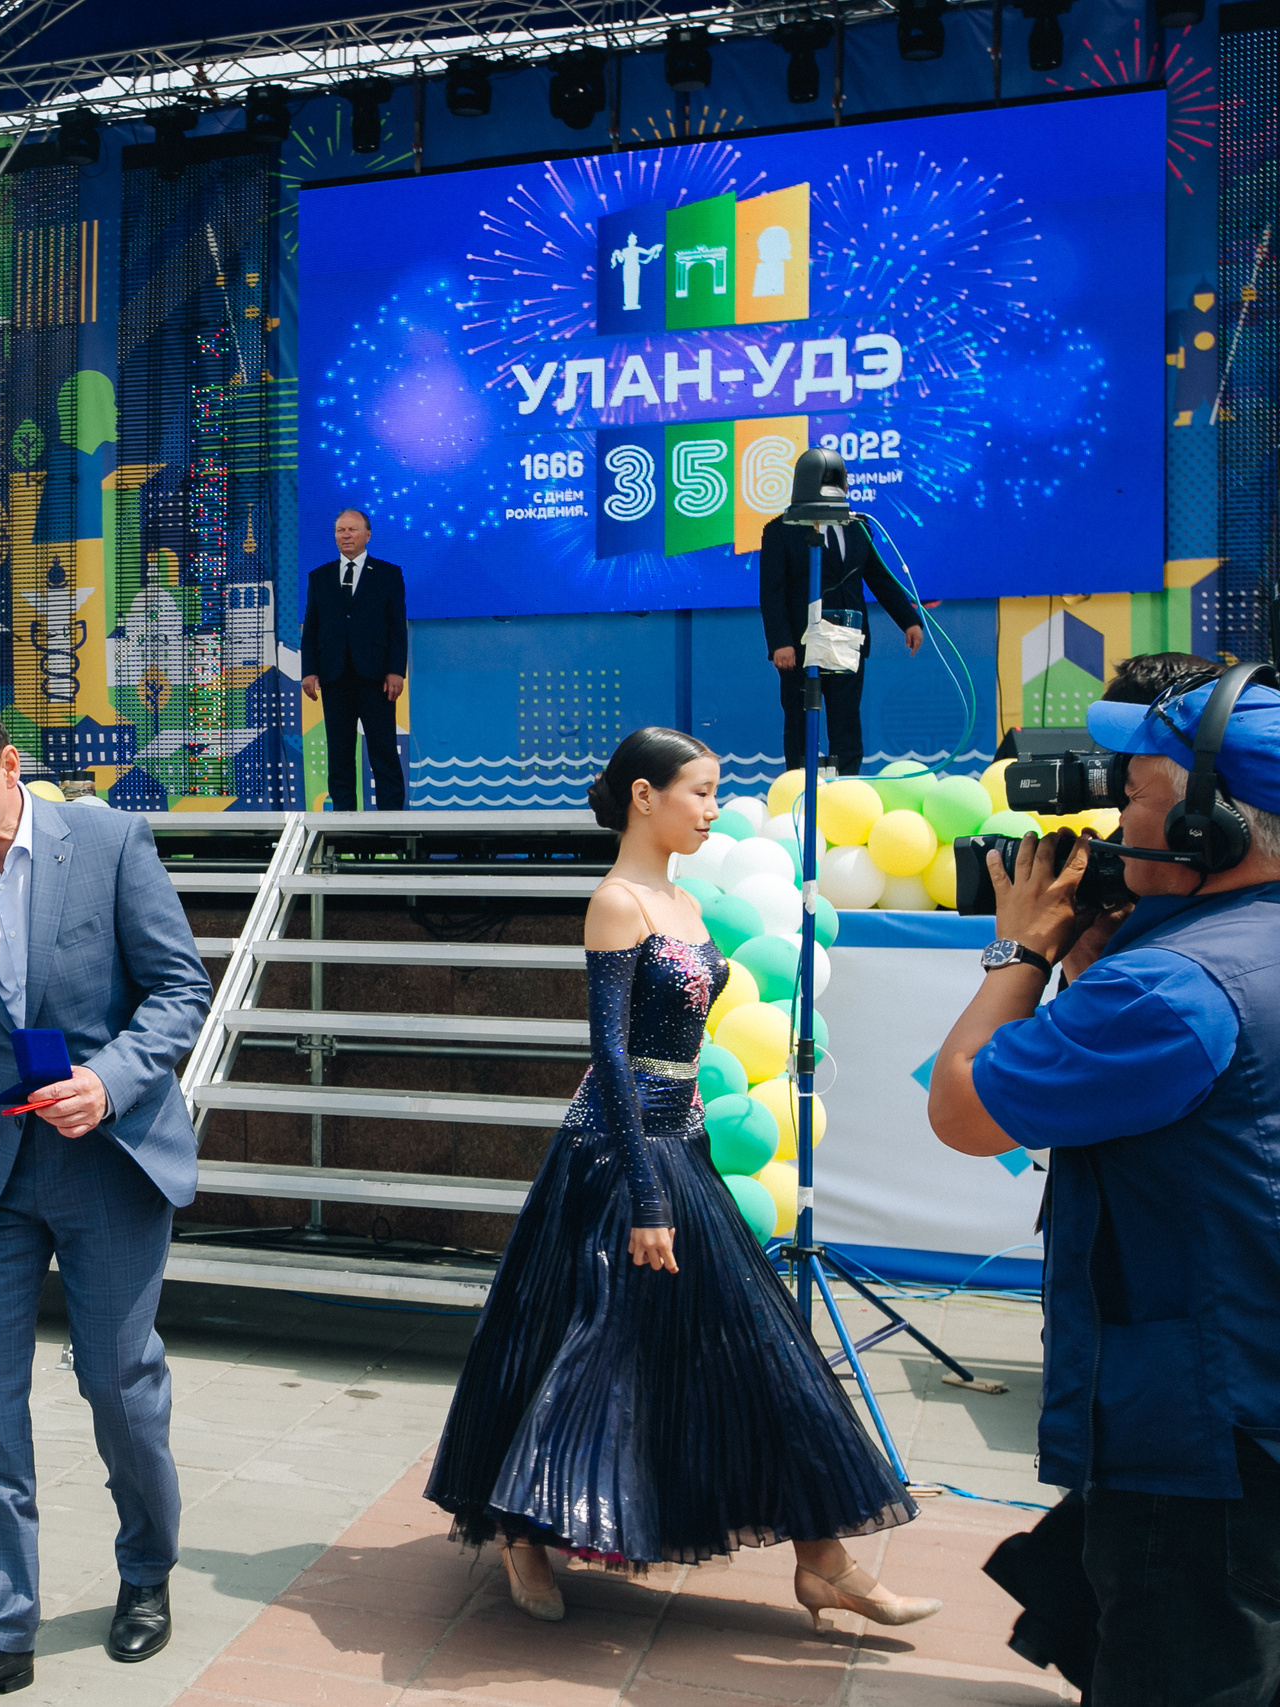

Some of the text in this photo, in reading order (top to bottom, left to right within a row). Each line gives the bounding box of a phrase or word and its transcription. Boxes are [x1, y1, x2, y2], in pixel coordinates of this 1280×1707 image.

[511, 333, 904, 414] УЛАН-УДЭ
[520, 451, 584, 480] 1666
[604, 435, 796, 521] 356
[846, 468, 903, 486] БИМЫЙ
[533, 488, 584, 504] С ДНЁМ
[846, 488, 876, 502] ОД!
[505, 505, 588, 520] РОЖДЕНИЯ.
